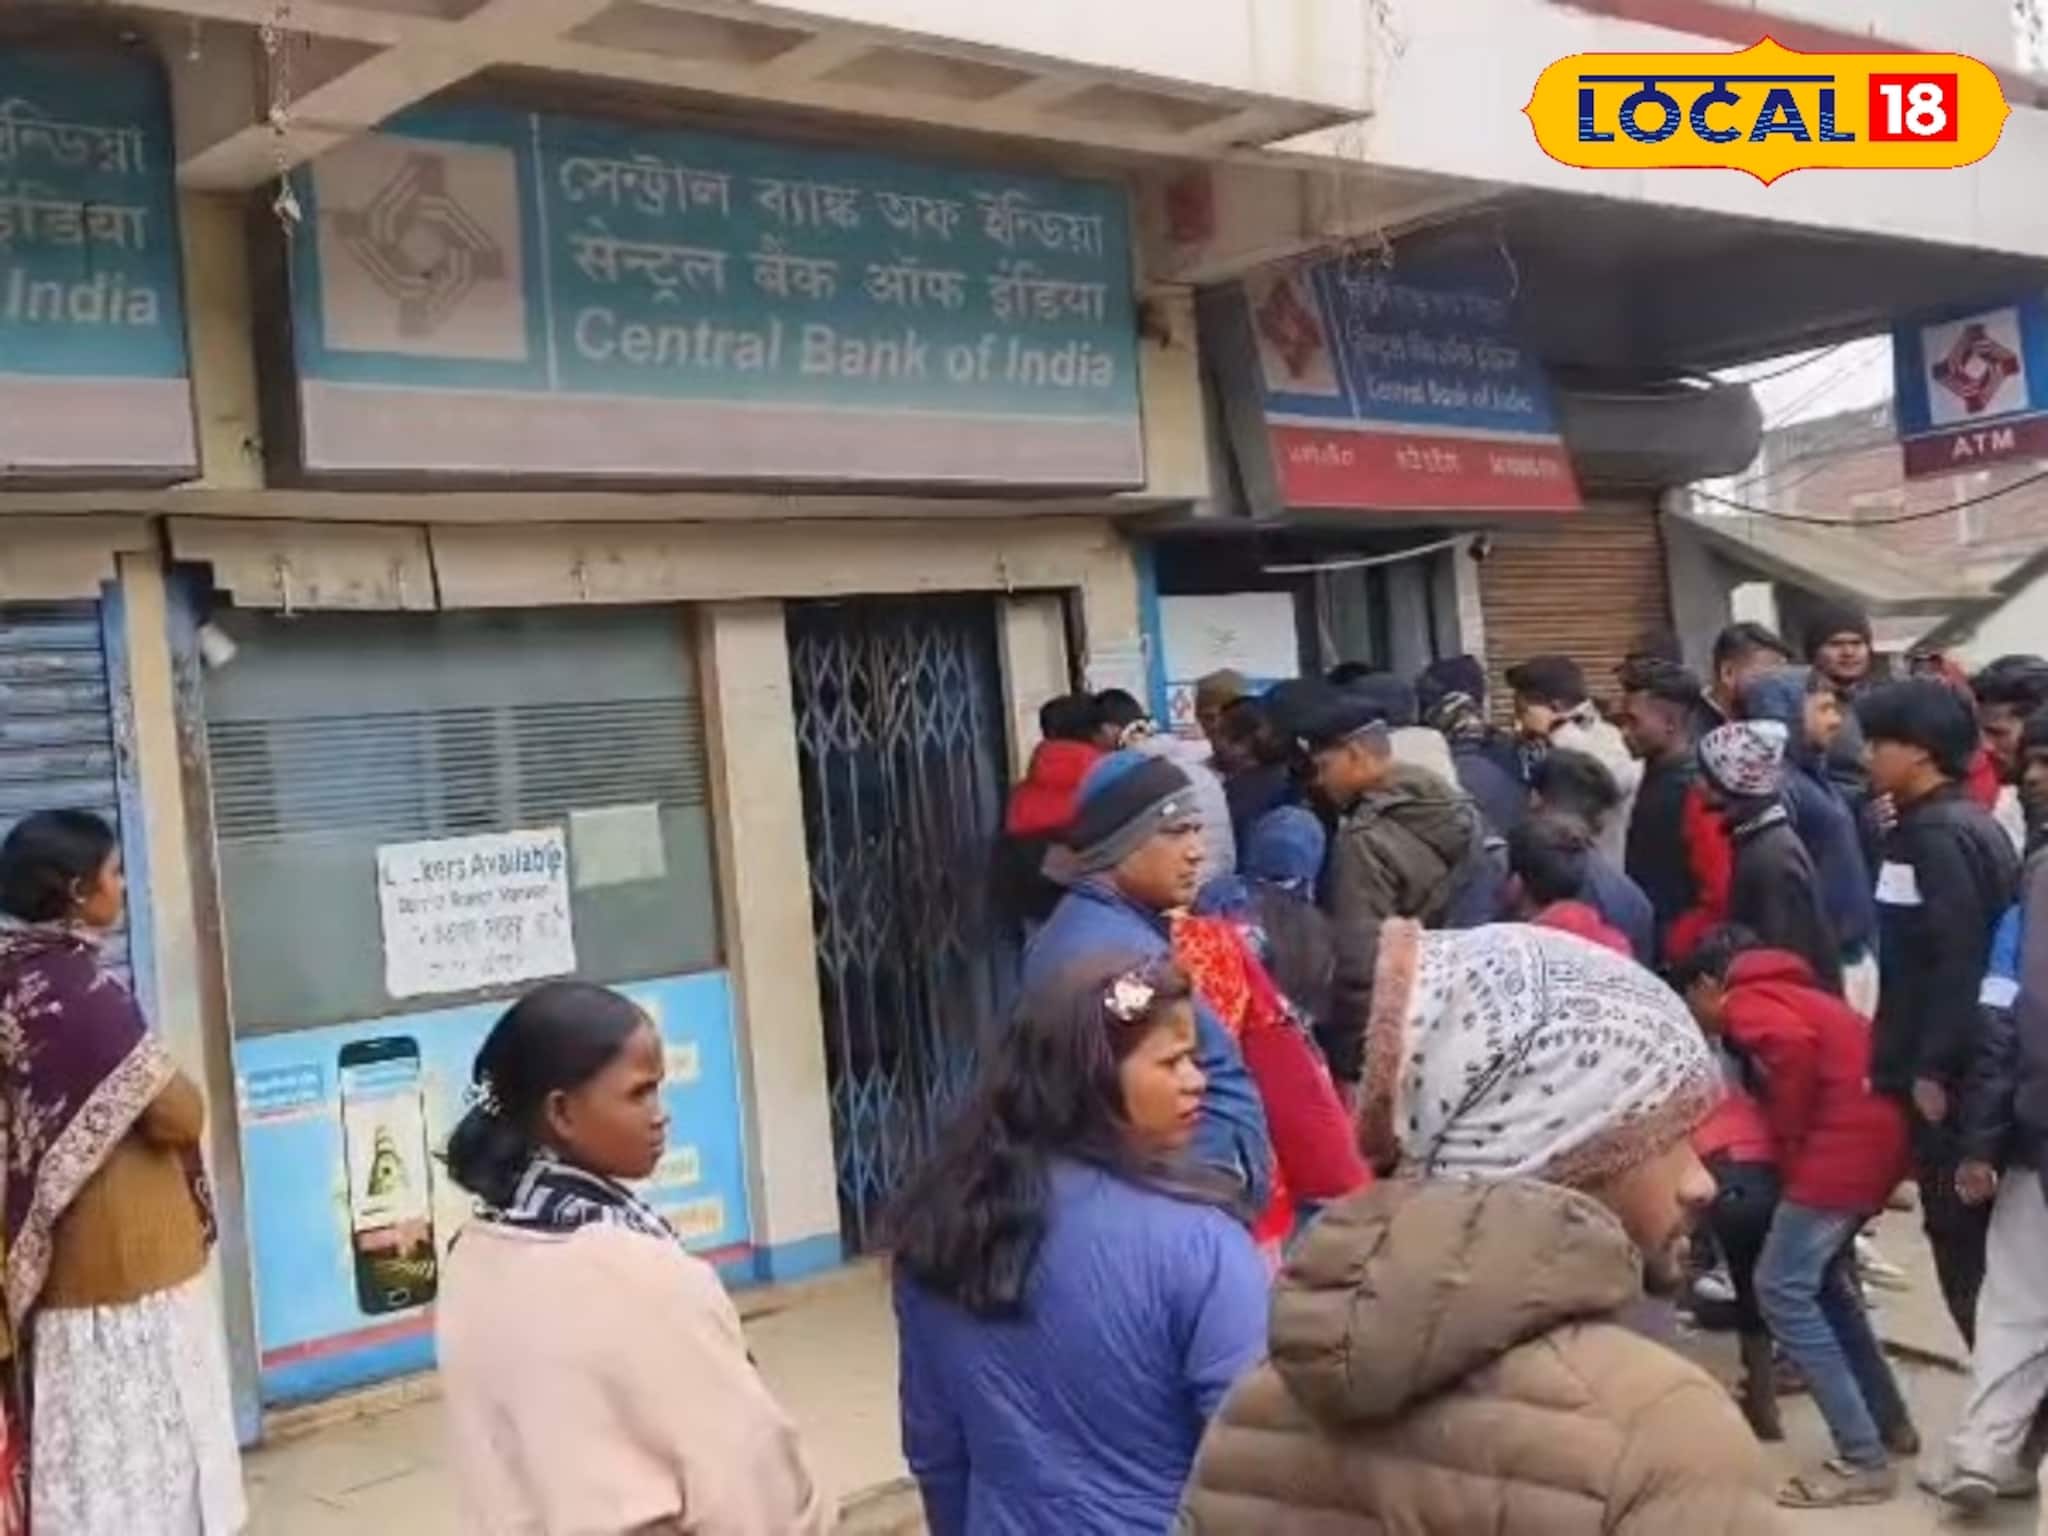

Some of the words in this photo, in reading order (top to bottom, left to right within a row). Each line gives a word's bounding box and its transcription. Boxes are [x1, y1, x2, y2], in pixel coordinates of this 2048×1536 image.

[7, 268, 160, 325] India
[748, 232, 838, 299] बैंक
[987, 257, 1109, 322] इंडिया
[573, 308, 783, 377] Central
[799, 322, 928, 381] Bank
[946, 332, 996, 381] of
[1006, 335, 1114, 389] India
[1951, 427, 2016, 458] ATM
[382, 856, 467, 887] Lkers
